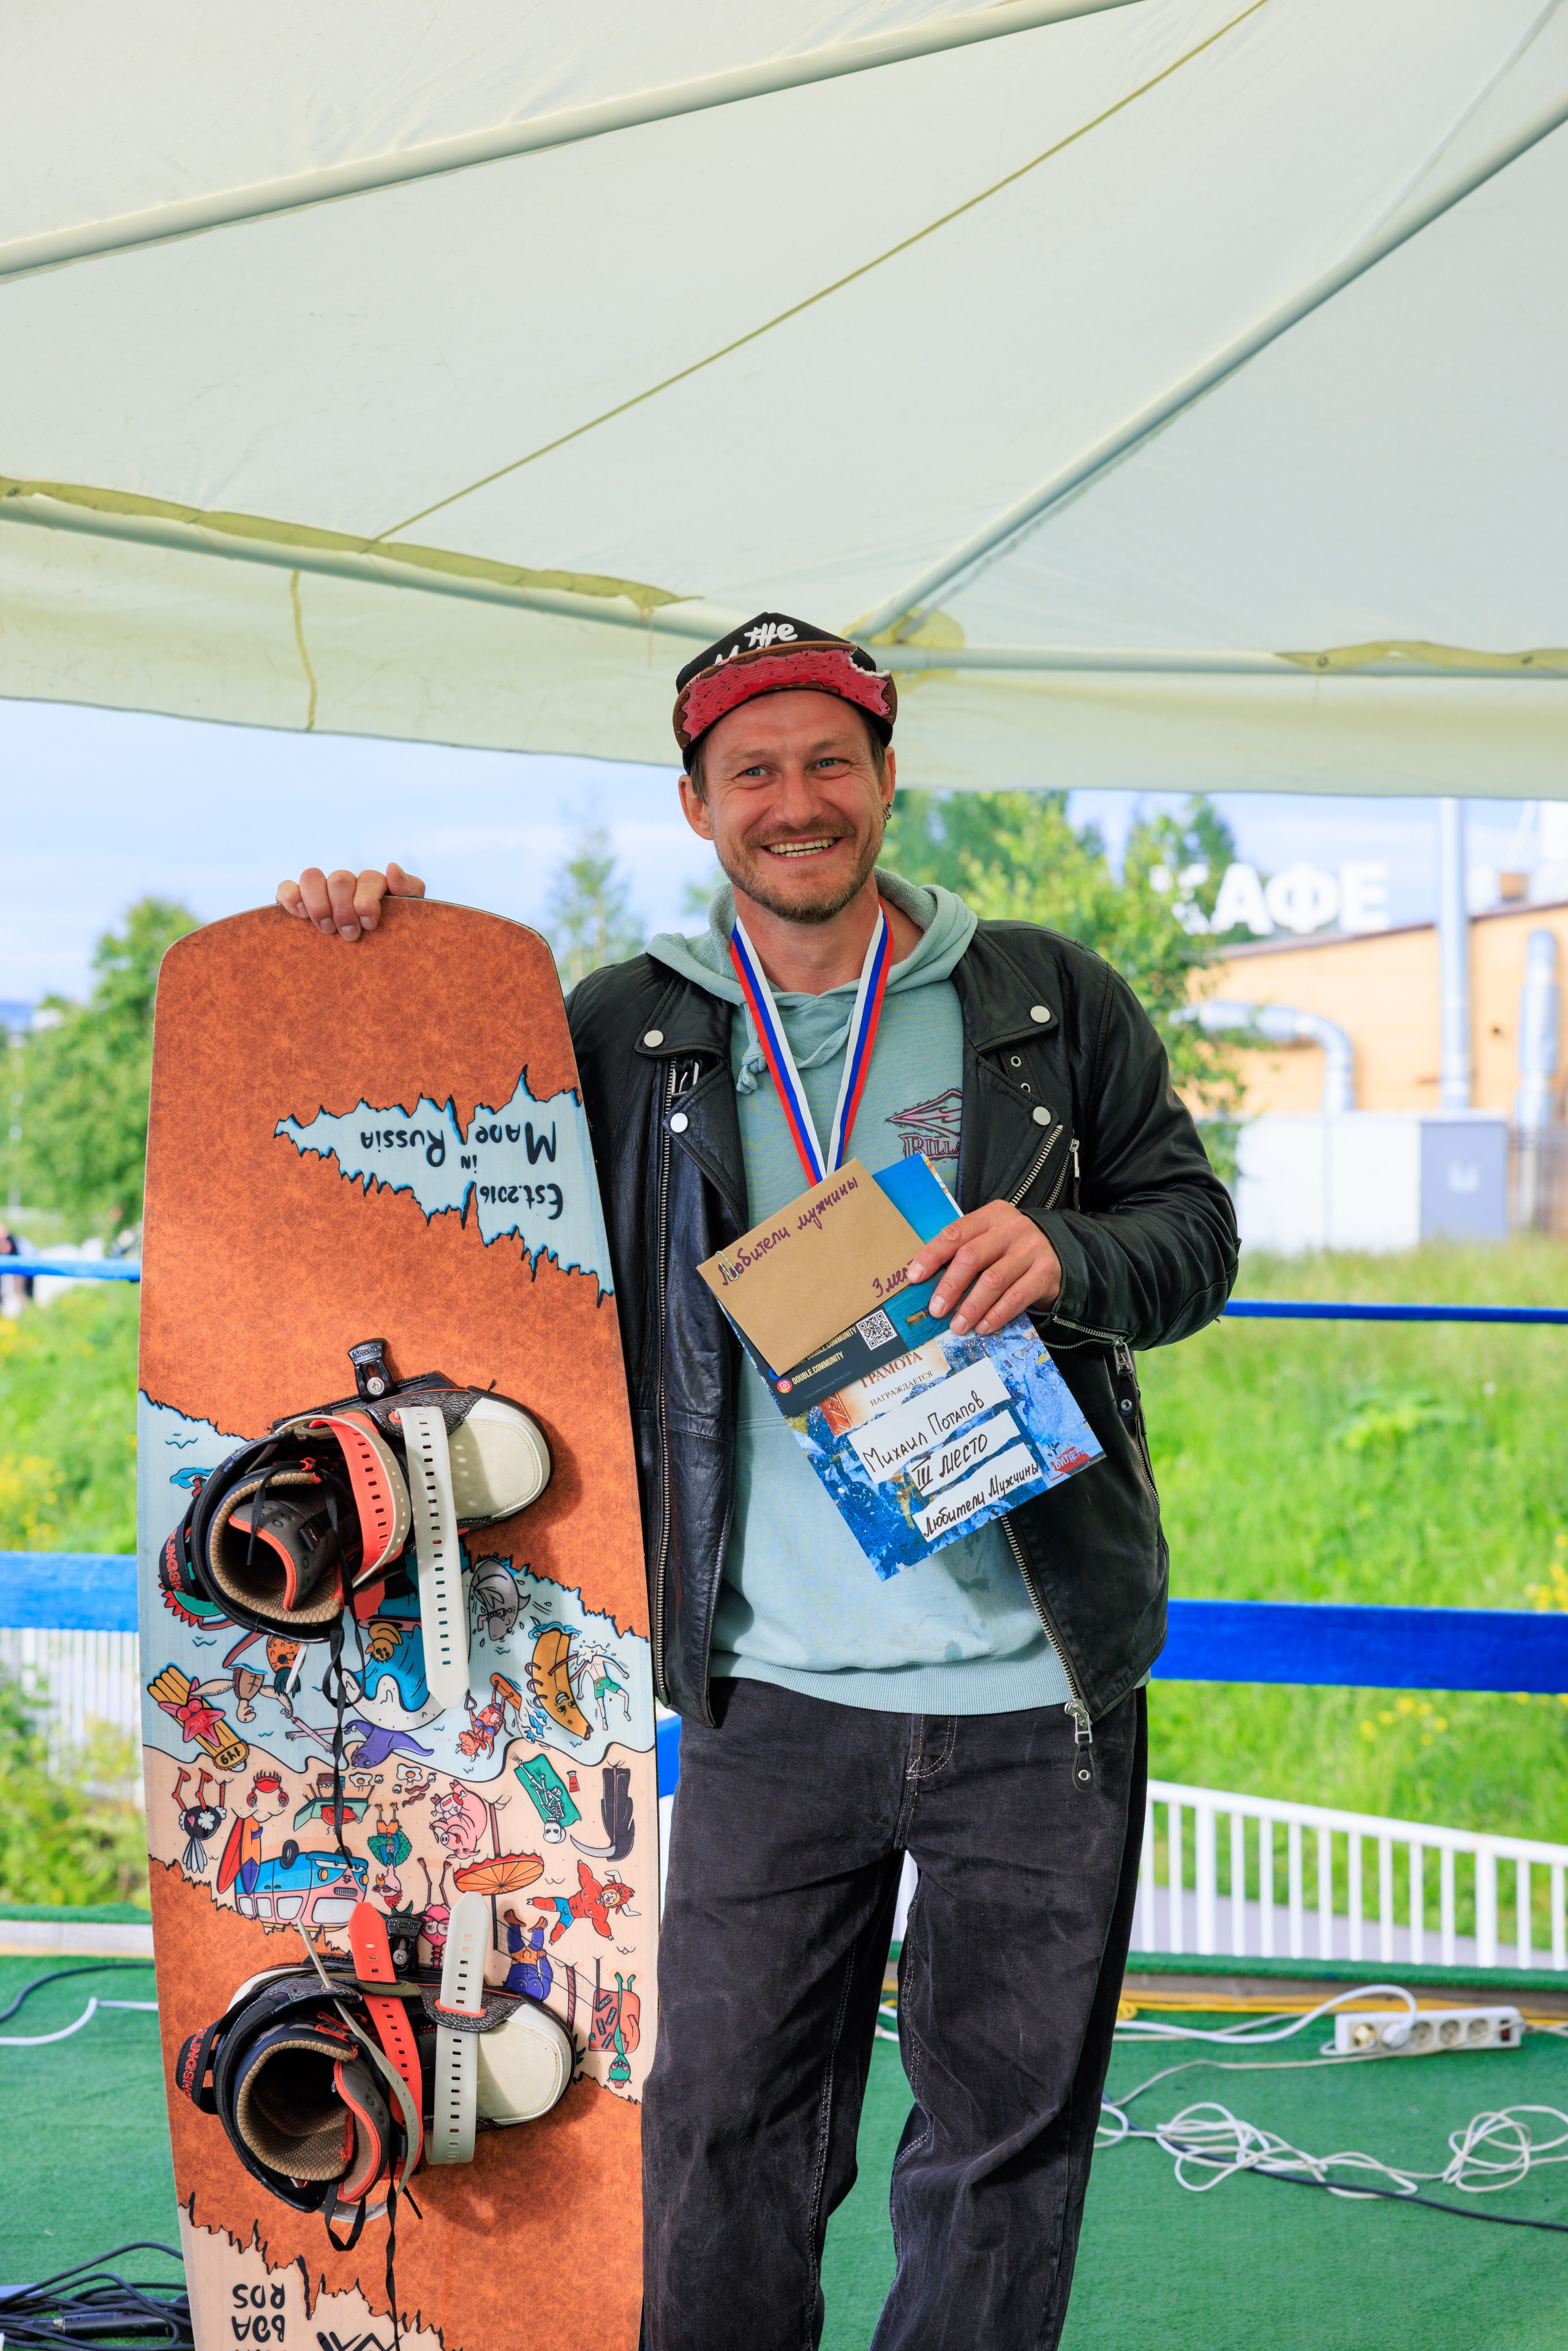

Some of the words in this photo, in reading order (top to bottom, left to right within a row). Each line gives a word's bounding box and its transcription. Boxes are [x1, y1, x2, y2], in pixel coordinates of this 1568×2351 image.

[791, 1351, 844, 1385] DOUBLE.COMMUNITY
[860, 1351, 923, 1388] ГРАМОТА
[870, 1371, 933, 1406] НАГРАЖДАЕТСЯ
[924, 1492, 986, 1538] Любители
[190, 1715, 208, 1730] EPIC
[221, 1746, 241, 1765] 149
